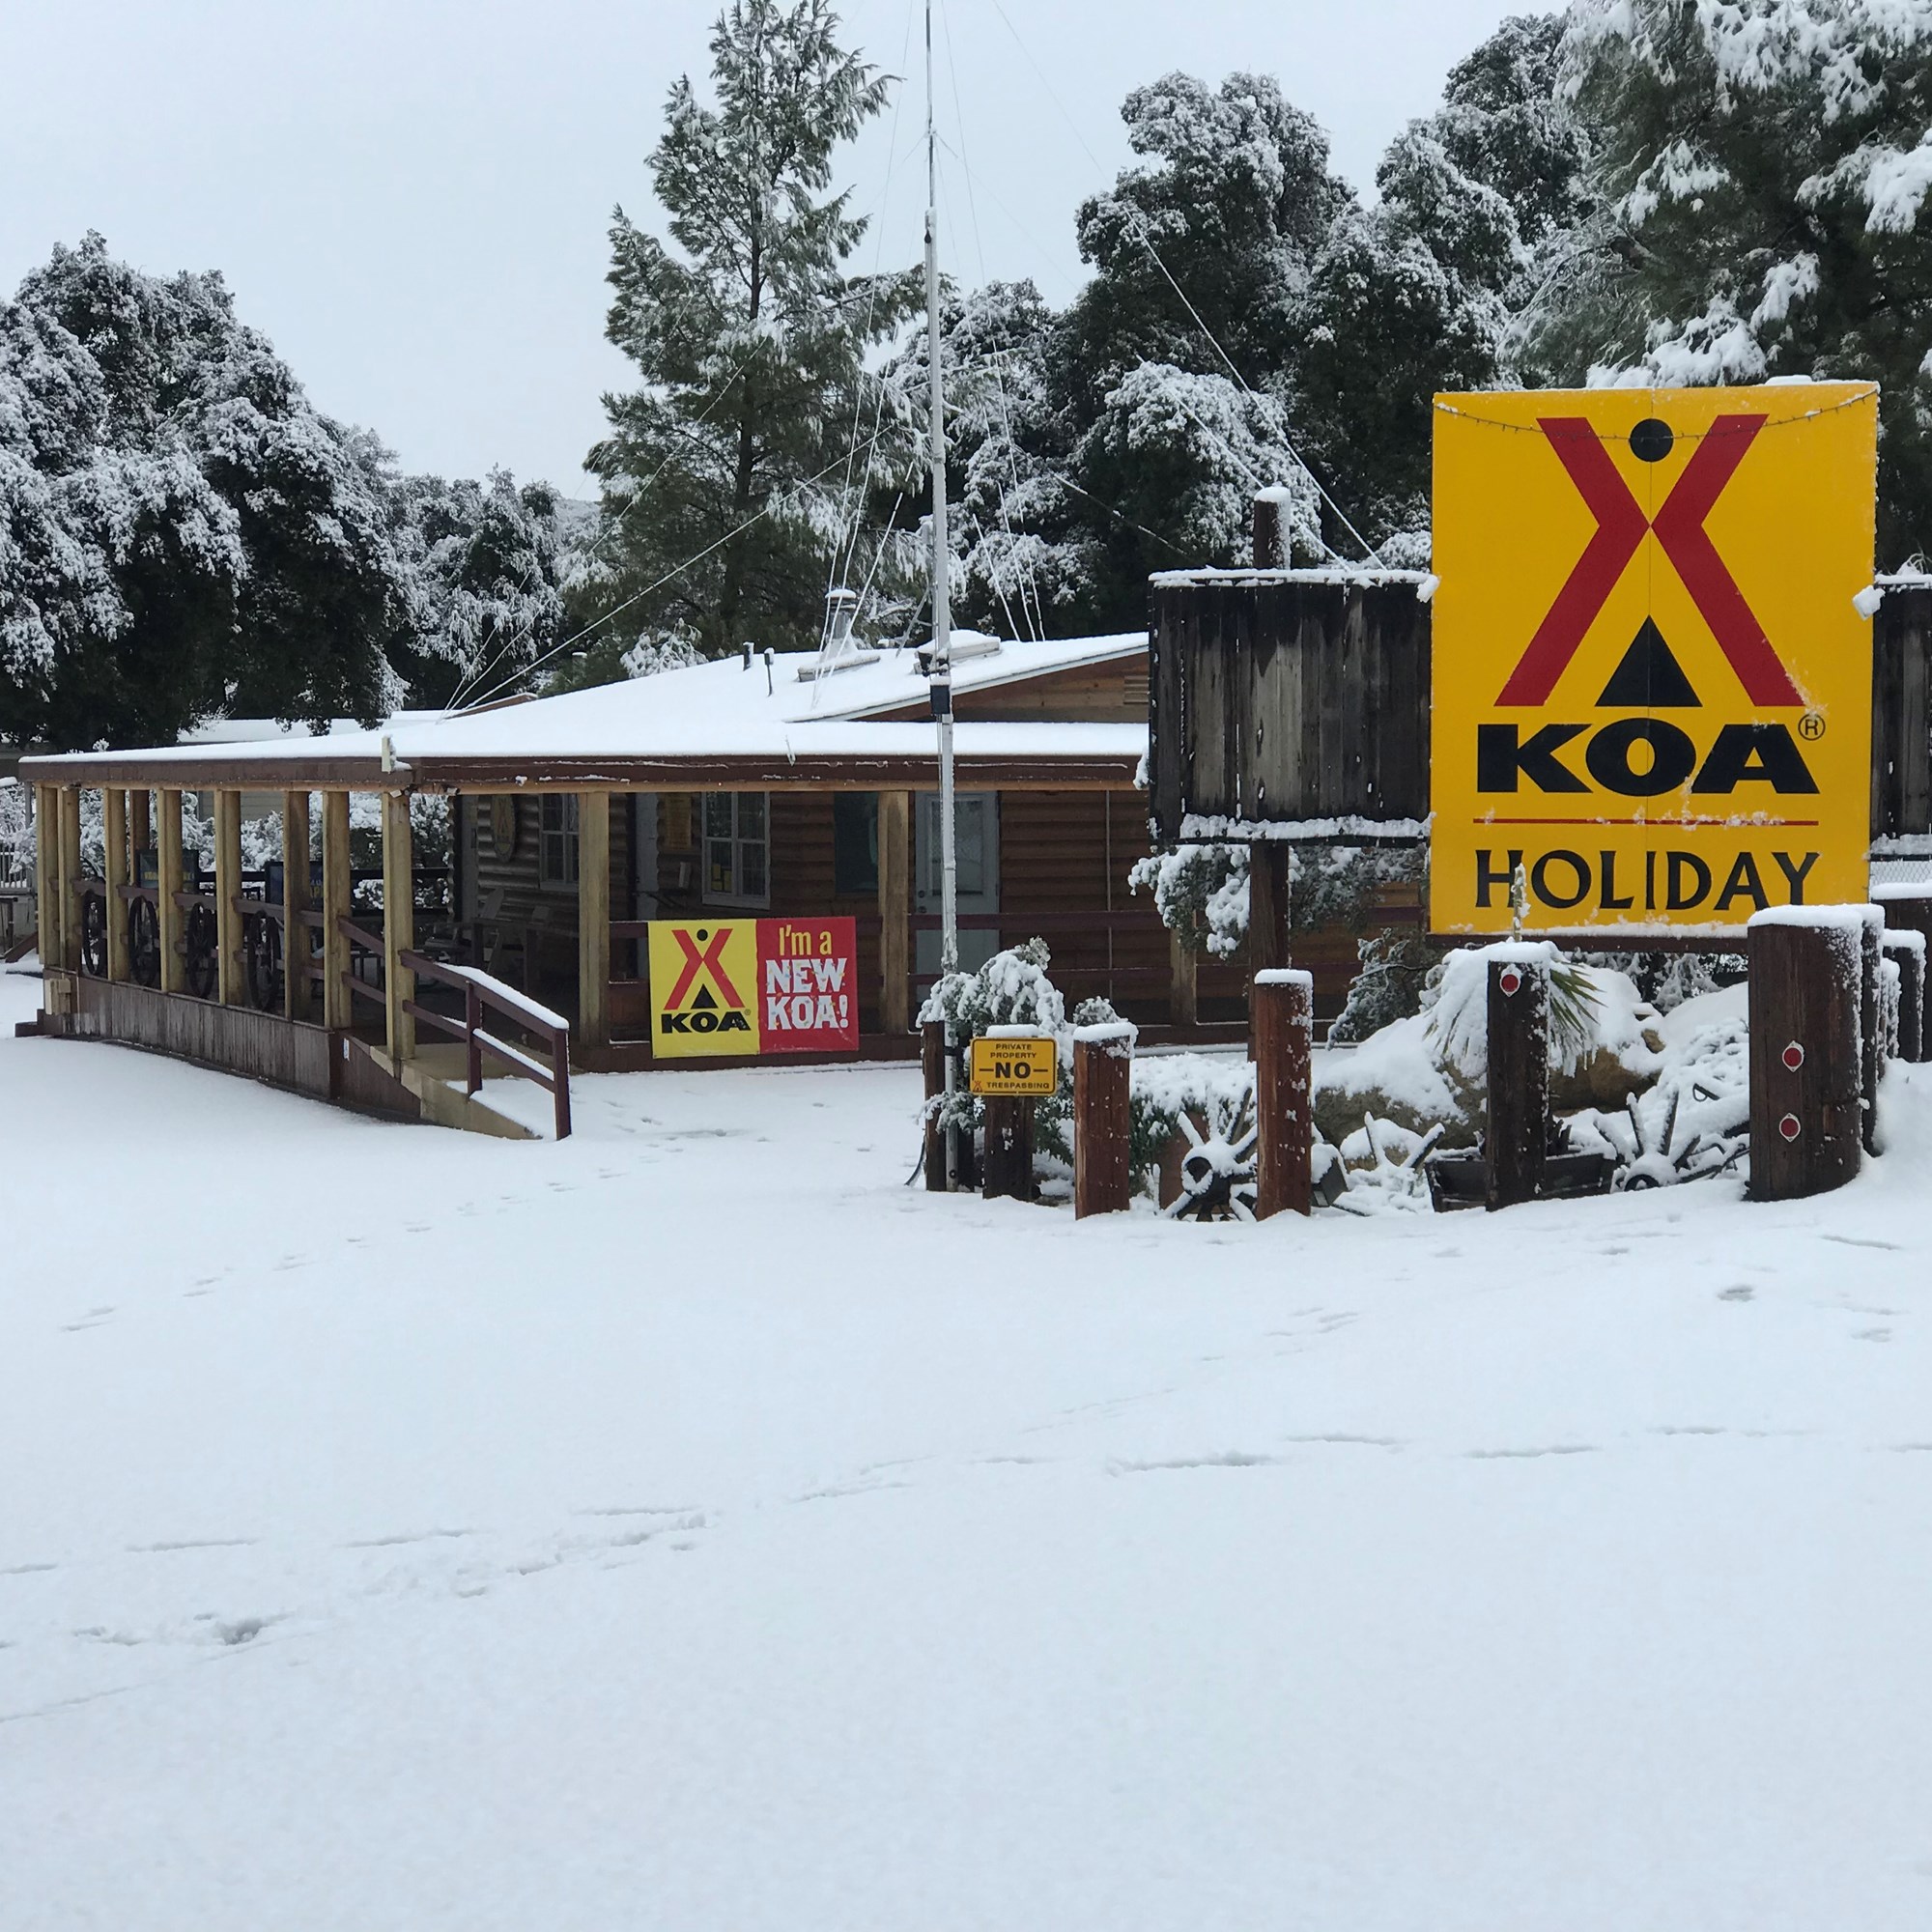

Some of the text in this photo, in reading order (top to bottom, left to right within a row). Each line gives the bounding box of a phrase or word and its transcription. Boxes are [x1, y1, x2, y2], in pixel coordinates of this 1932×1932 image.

[1477, 718, 1820, 797] KOA
[1475, 849, 1821, 910] HOLIDAY
[779, 924, 833, 956] I'm a
[765, 957, 847, 994] NEW
[661, 1010, 752, 1035] KOA
[766, 994, 849, 1031] KOA!
[995, 1062, 1031, 1079] NO
